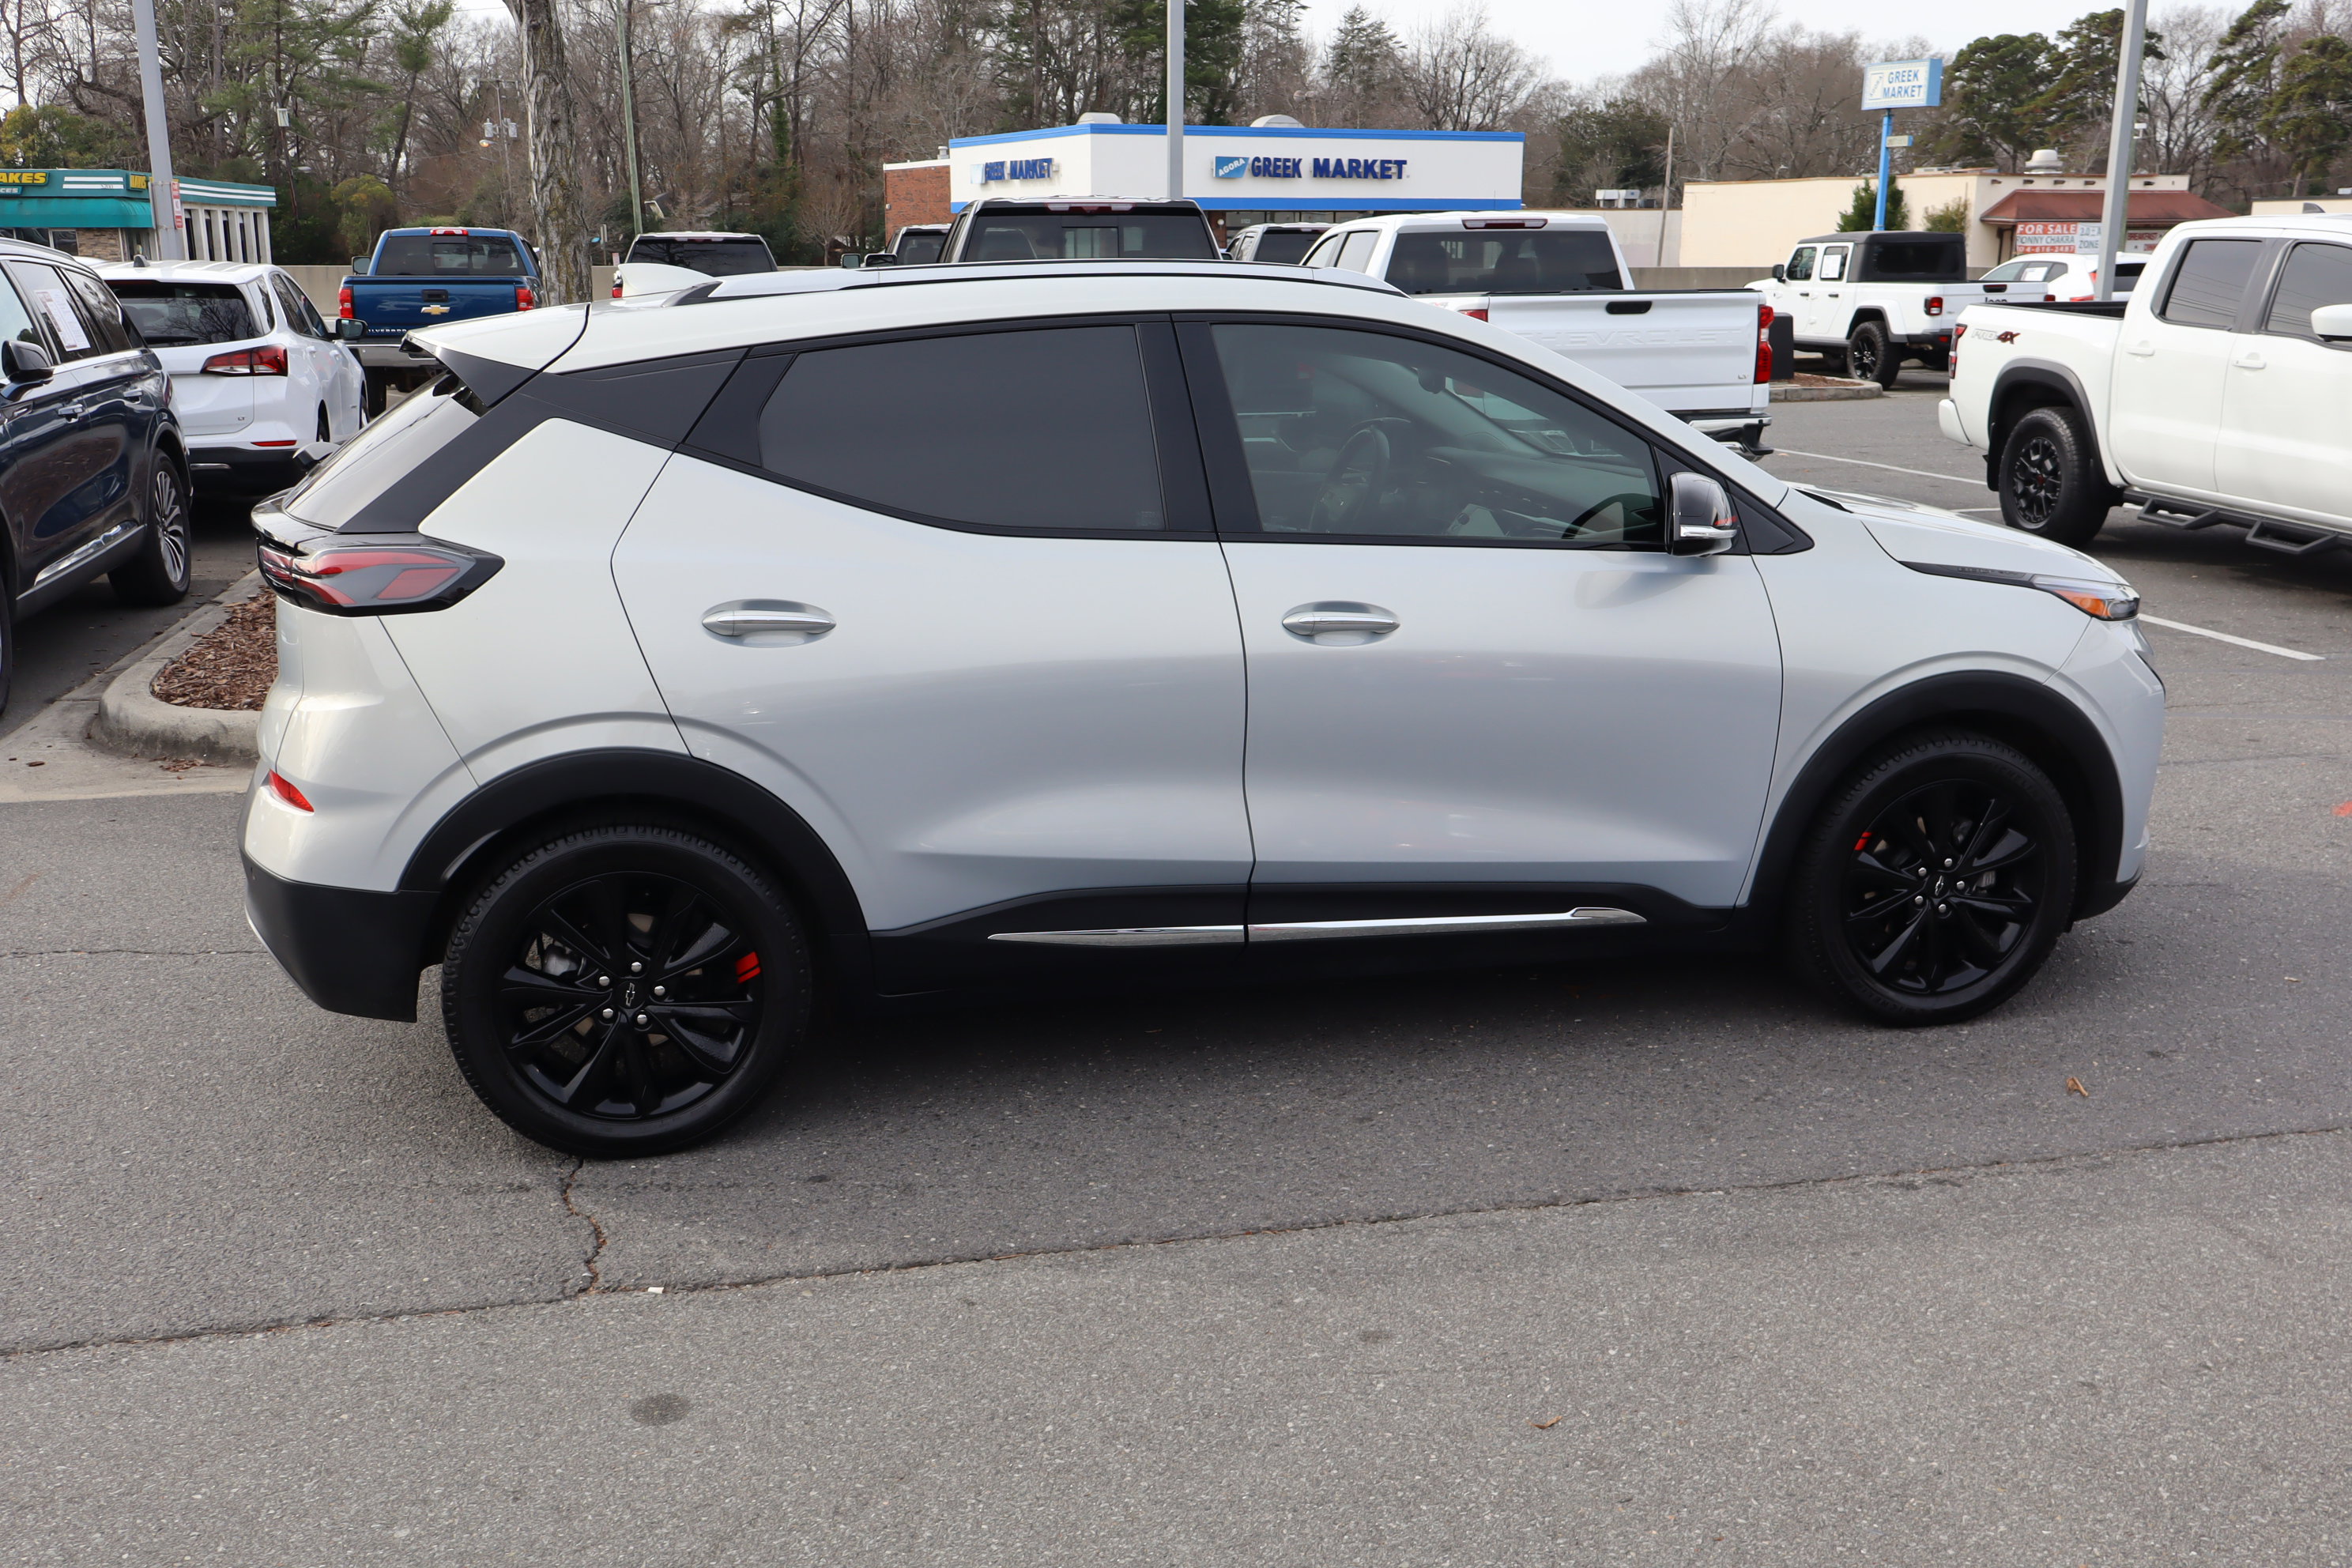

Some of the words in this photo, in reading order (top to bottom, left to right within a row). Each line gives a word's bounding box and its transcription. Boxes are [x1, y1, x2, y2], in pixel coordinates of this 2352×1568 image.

[1888, 70, 1920, 84] GREEK
[1883, 85, 1923, 99] MARKET
[1010, 158, 1053, 180] MARKET
[1218, 158, 1246, 177] AGORA
[1251, 156, 1303, 179] GREEK
[1313, 158, 1408, 180] MARKET
[2017, 224, 2044, 235] FOR
[2047, 224, 2077, 235] SALE
